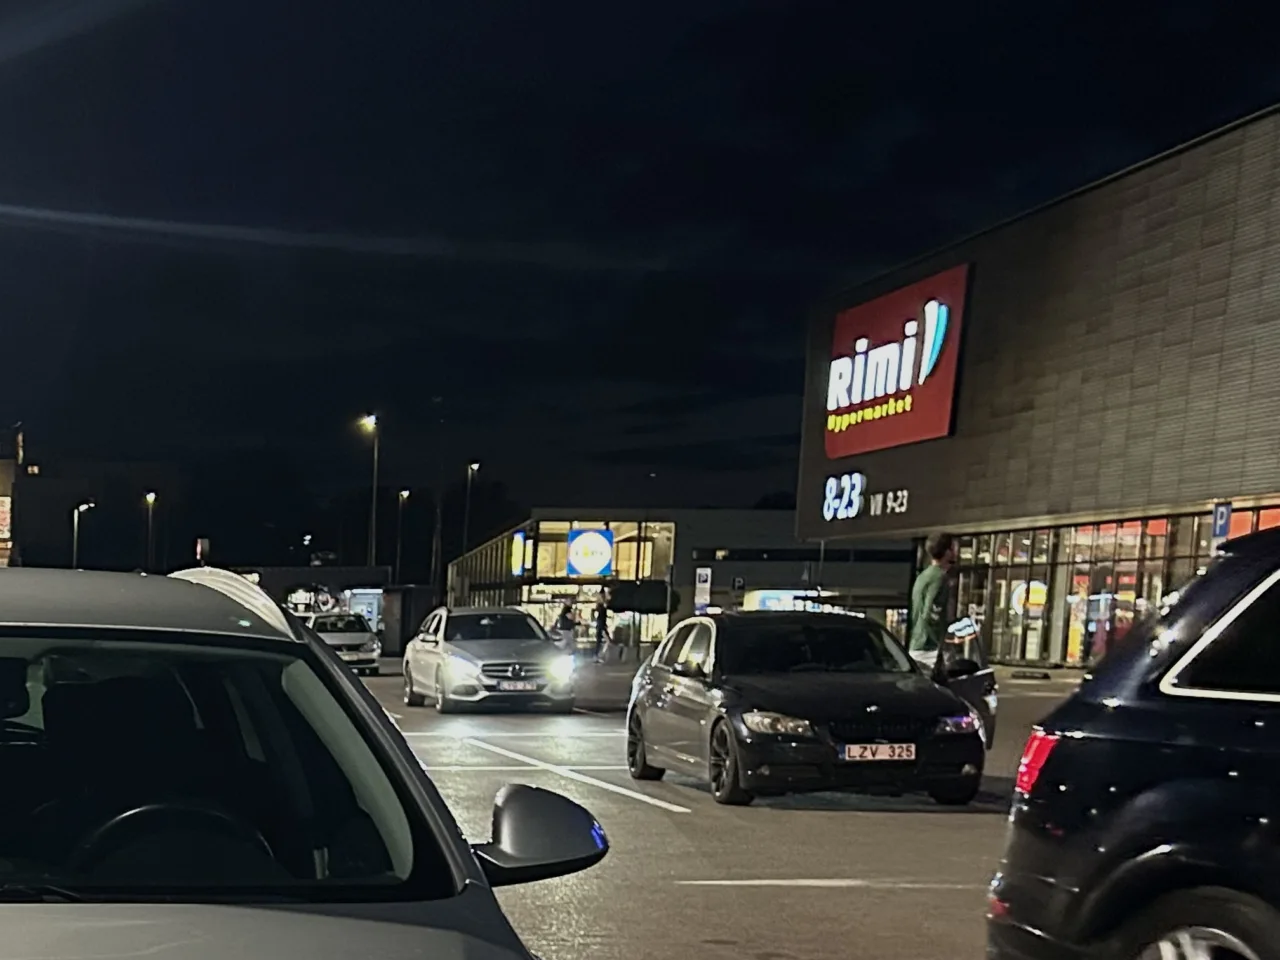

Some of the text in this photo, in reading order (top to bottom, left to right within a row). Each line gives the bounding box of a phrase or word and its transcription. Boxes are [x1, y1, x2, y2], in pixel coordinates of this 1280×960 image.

[826, 320, 918, 411] Rimi
[827, 394, 912, 433] Hypermarket
[823, 472, 863, 521] 8-23
[1215, 506, 1227, 535] P
[847, 744, 913, 758] LZV 325
